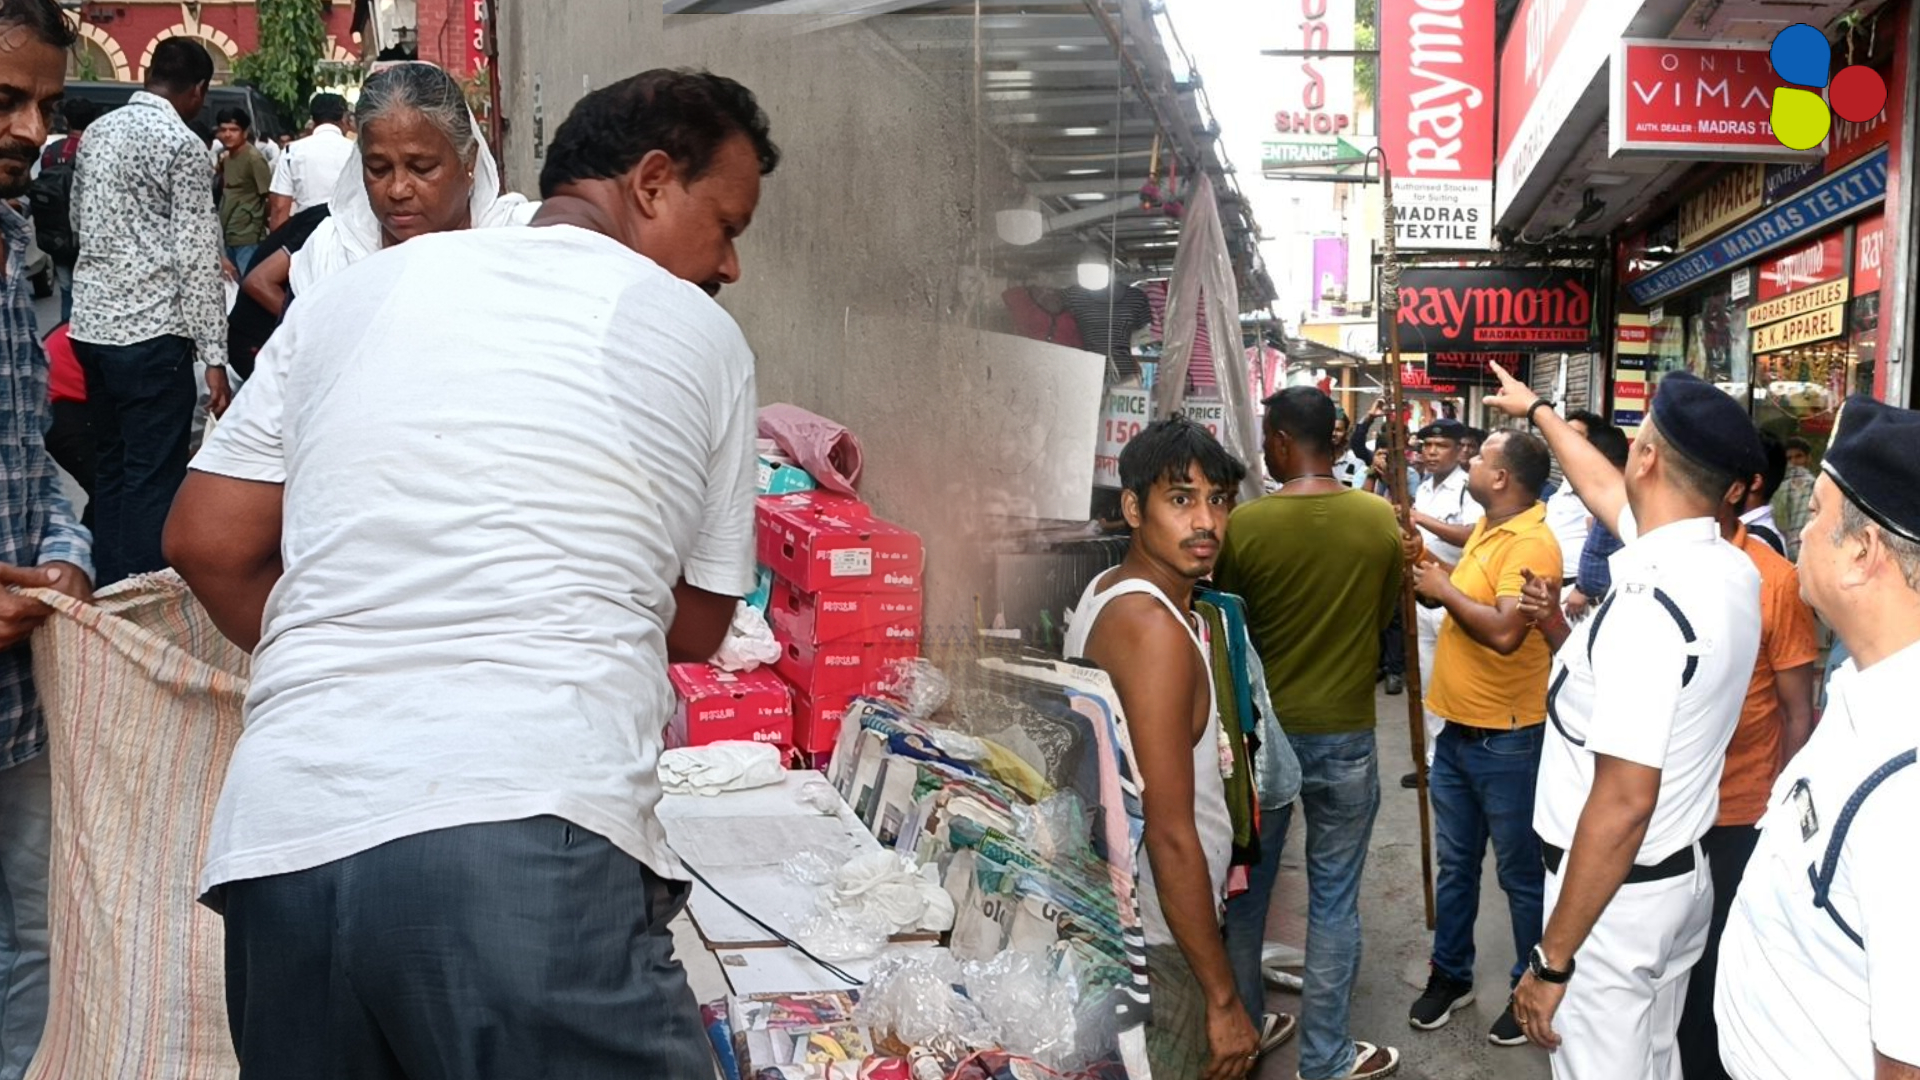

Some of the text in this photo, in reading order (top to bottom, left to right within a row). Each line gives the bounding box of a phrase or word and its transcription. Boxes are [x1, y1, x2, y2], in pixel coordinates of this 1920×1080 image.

[1632, 78, 1771, 108] VIMA
[1275, 111, 1349, 134] SHOP
[1661, 124, 1692, 132] DEALER
[1699, 120, 1755, 134] MADRAS
[1264, 145, 1338, 161] ENTRANCE
[1394, 183, 1479, 192] Authorised Stockist
[1414, 193, 1458, 203] for Suiting
[1393, 206, 1479, 222] MADRAS
[1394, 224, 1477, 240] TEXTILE
[1722, 207, 1804, 258] MADRAS
[1397, 279, 1590, 338] Raymond
[1750, 284, 1841, 323] MADRAS TEXTILES
[1783, 311, 1834, 342] APPAREL
[1479, 330, 1586, 340] MADRAS TEXTILES
[1110, 395, 1145, 414] PRICE
[1188, 407, 1221, 419] PRICE
